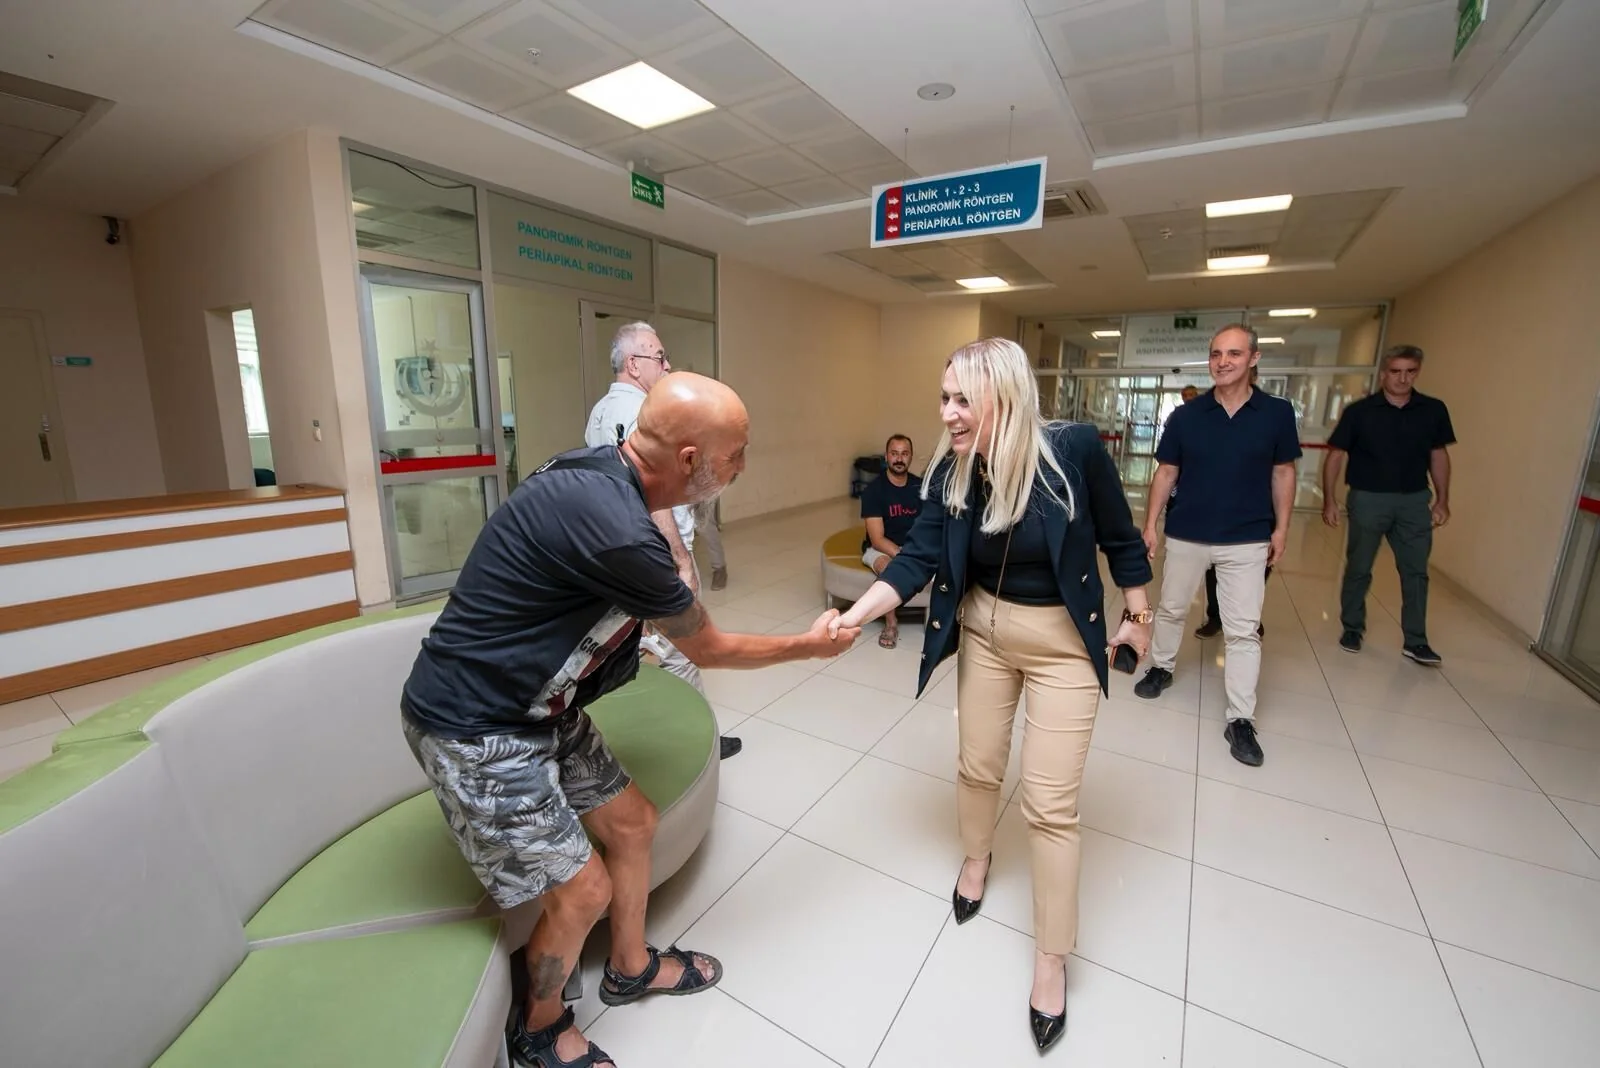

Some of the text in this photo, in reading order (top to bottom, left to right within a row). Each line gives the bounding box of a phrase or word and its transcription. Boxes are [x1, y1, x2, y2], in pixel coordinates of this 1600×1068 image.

[904, 192, 1014, 216] PANOROMİK RÖNTGEN
[905, 187, 938, 204] KLİNİK
[959, 185, 965, 195] 2
[974, 183, 980, 193] 3
[904, 208, 1021, 232] PERİAPİKAL RÖNTGEN
[519, 246, 584, 271] PERİAPİKAL
